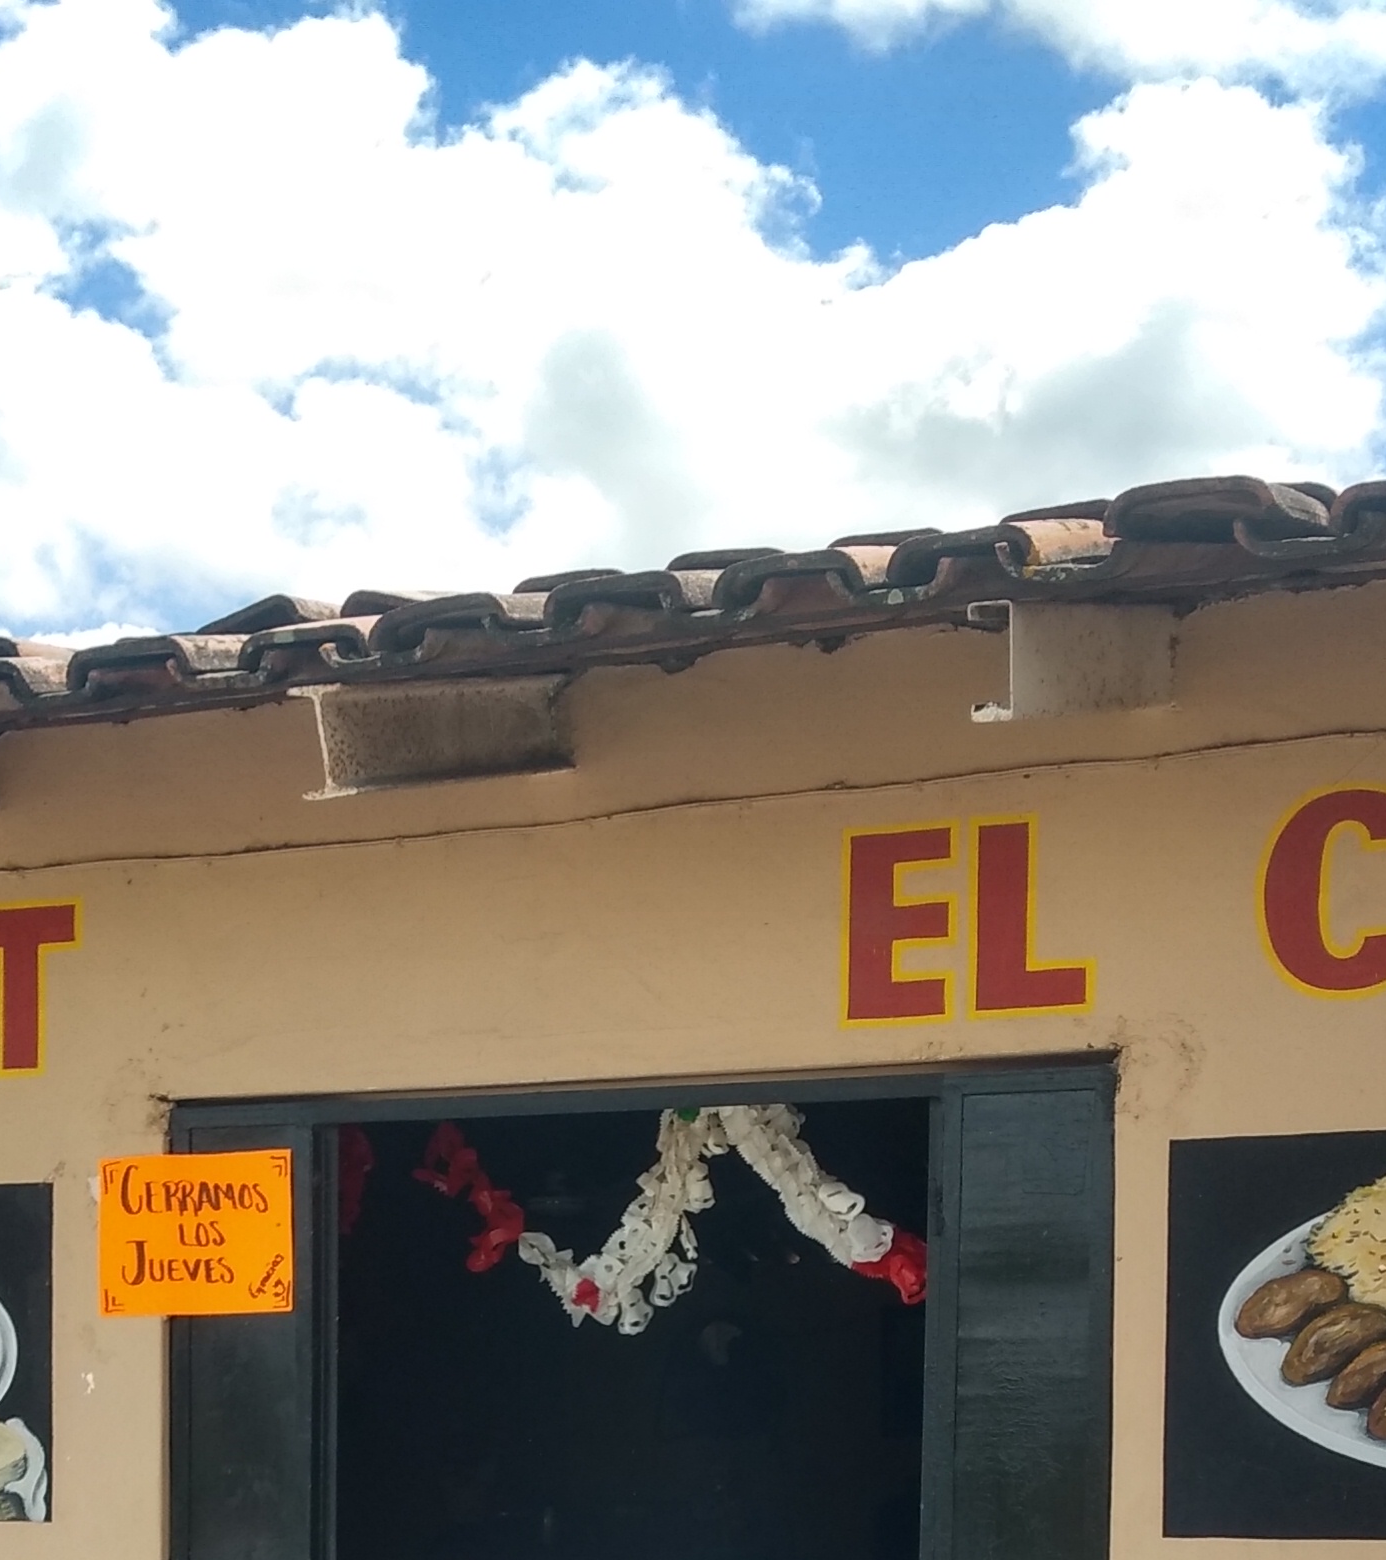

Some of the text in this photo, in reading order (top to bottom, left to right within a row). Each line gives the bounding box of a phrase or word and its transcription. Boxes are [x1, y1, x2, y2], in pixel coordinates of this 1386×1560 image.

[840, 812, 1095, 1028] EL
[120, 1164, 269, 1217] CERRAMOS
[178, 1220, 226, 1247] LOS
[121, 1239, 235, 1286] JUEVES
